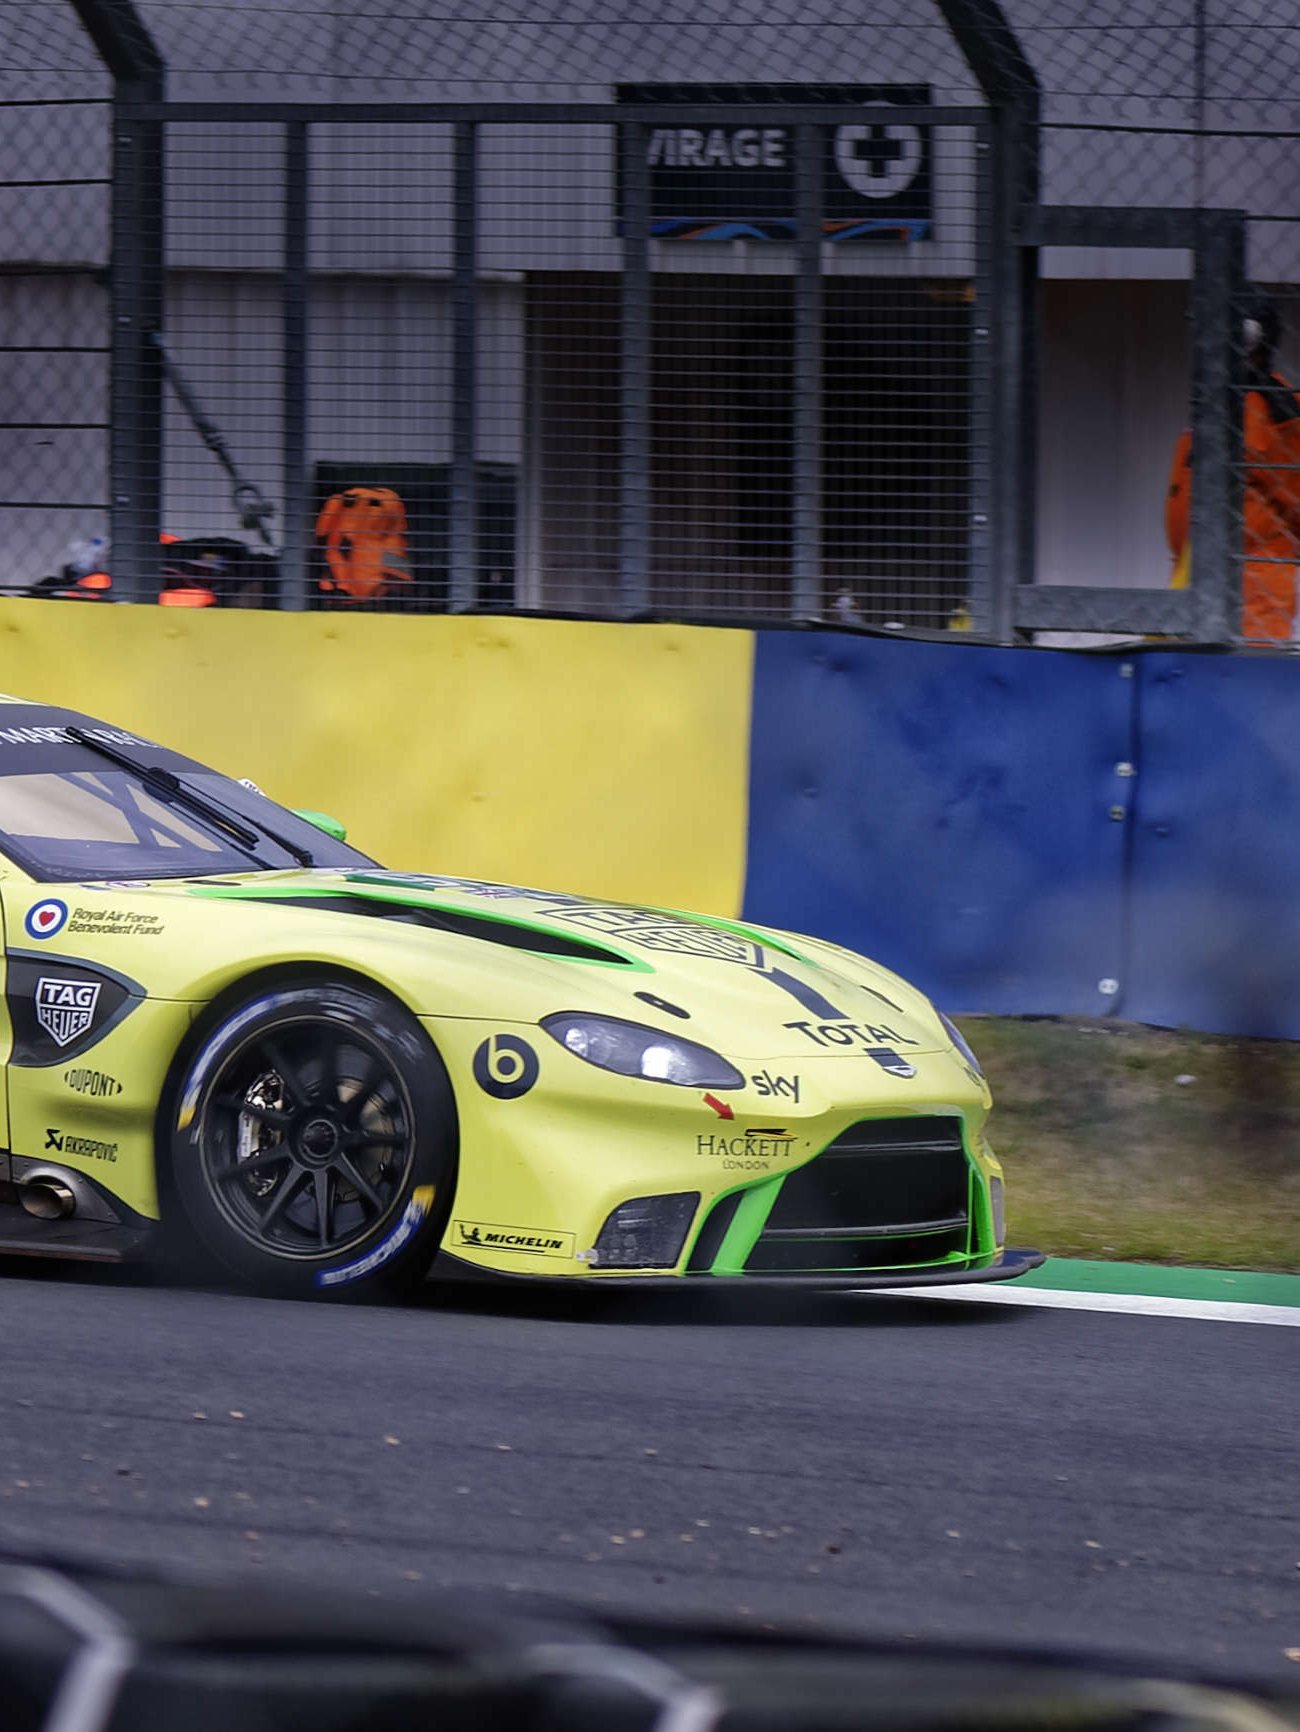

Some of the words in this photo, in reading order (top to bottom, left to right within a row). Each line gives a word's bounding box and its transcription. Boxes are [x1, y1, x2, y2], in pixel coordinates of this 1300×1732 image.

[73, 908, 104, 922] Royal
[106, 909, 124, 921] Air
[125, 911, 159, 924] Force
[68, 921, 131, 934] Benevolent
[132, 924, 164, 935] Fund
[43, 984, 94, 1006] TAG
[42, 1009, 89, 1040] HEUER
[782, 1022, 920, 1047] TOTAL
[68, 1069, 116, 1096] DUPONT
[751, 1069, 799, 1103] sky
[696, 1135, 795, 1156] HACKETT
[723, 1161, 769, 1170] LONDON
[484, 1233, 563, 1249] MICHELIN
